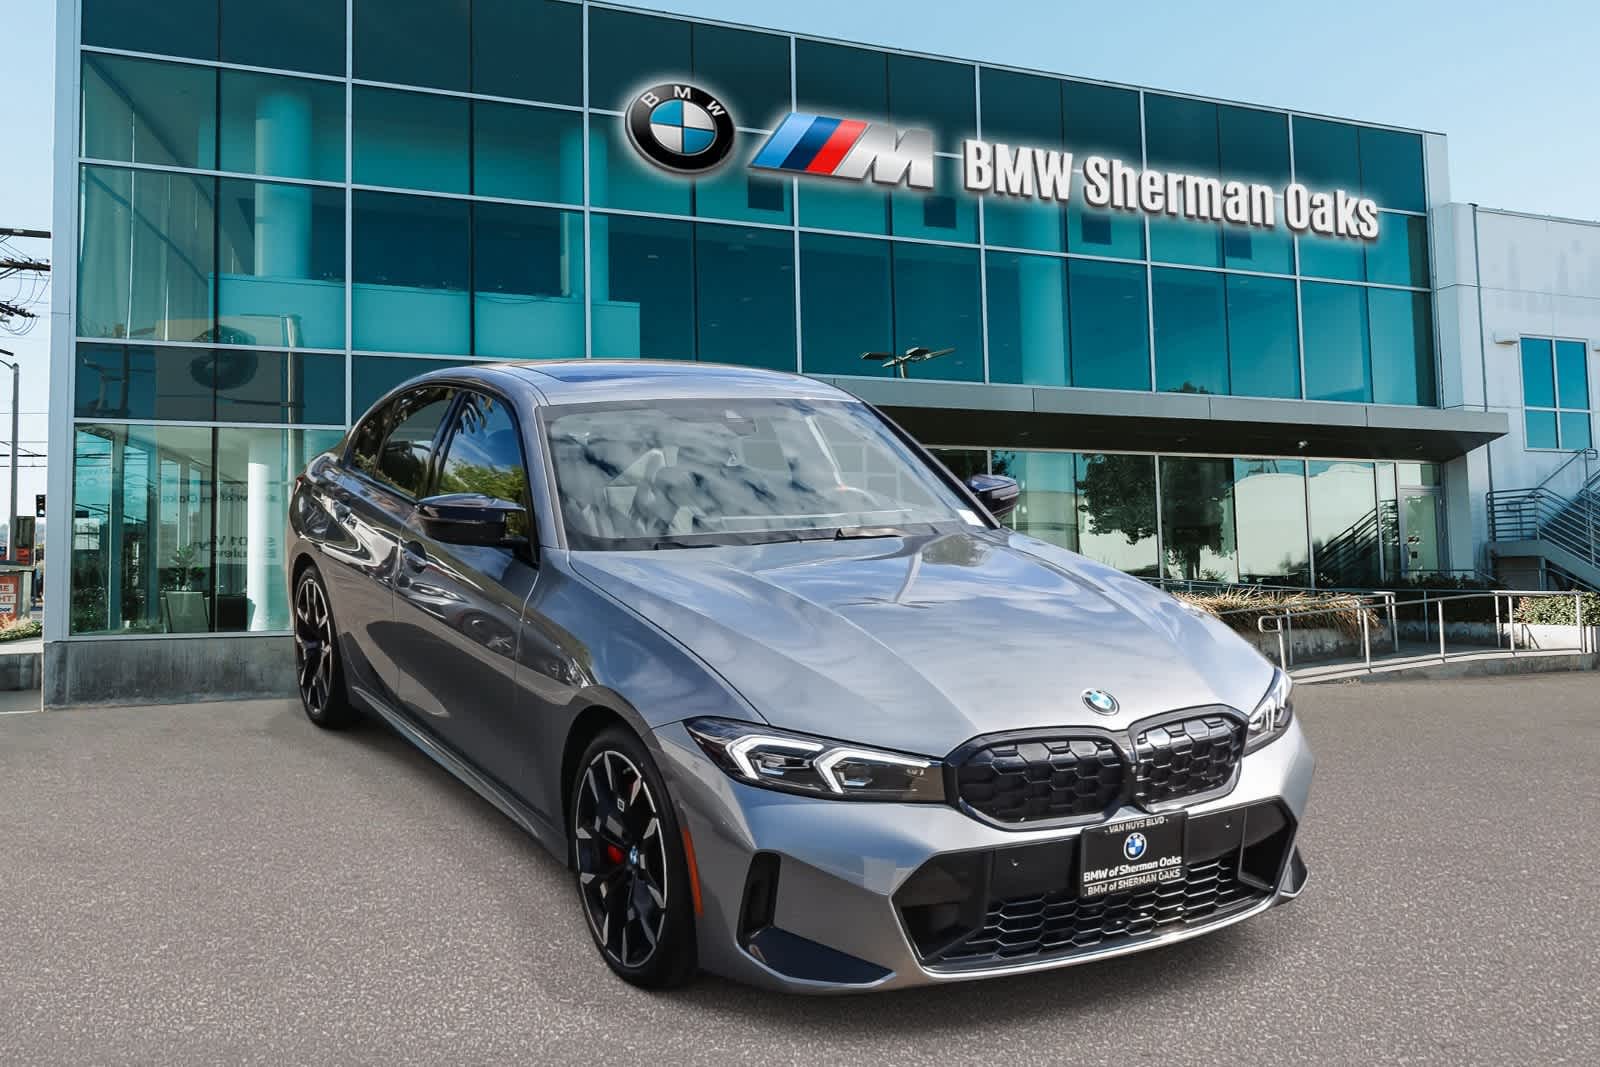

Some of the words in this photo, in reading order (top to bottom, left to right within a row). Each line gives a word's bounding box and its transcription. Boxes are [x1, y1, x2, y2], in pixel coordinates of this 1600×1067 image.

[964, 138, 1073, 202] BMW
[1082, 155, 1275, 226] Sherman
[1283, 183, 1379, 241] Oaks
[1109, 824, 1124, 833] VAN
[1126, 820, 1145, 830] NUYS
[1146, 816, 1164, 827] BLVD
[1083, 869, 1109, 882] BMW
[1109, 865, 1118, 876] of
[1119, 861, 1158, 874] Sherman
[1159, 856, 1182, 867] Oaks
[1087, 884, 1108, 896] BMW
[1109, 881, 1117, 891] of
[1118, 874, 1157, 889] SHERMAN
[1158, 869, 1180, 880] OAKS
